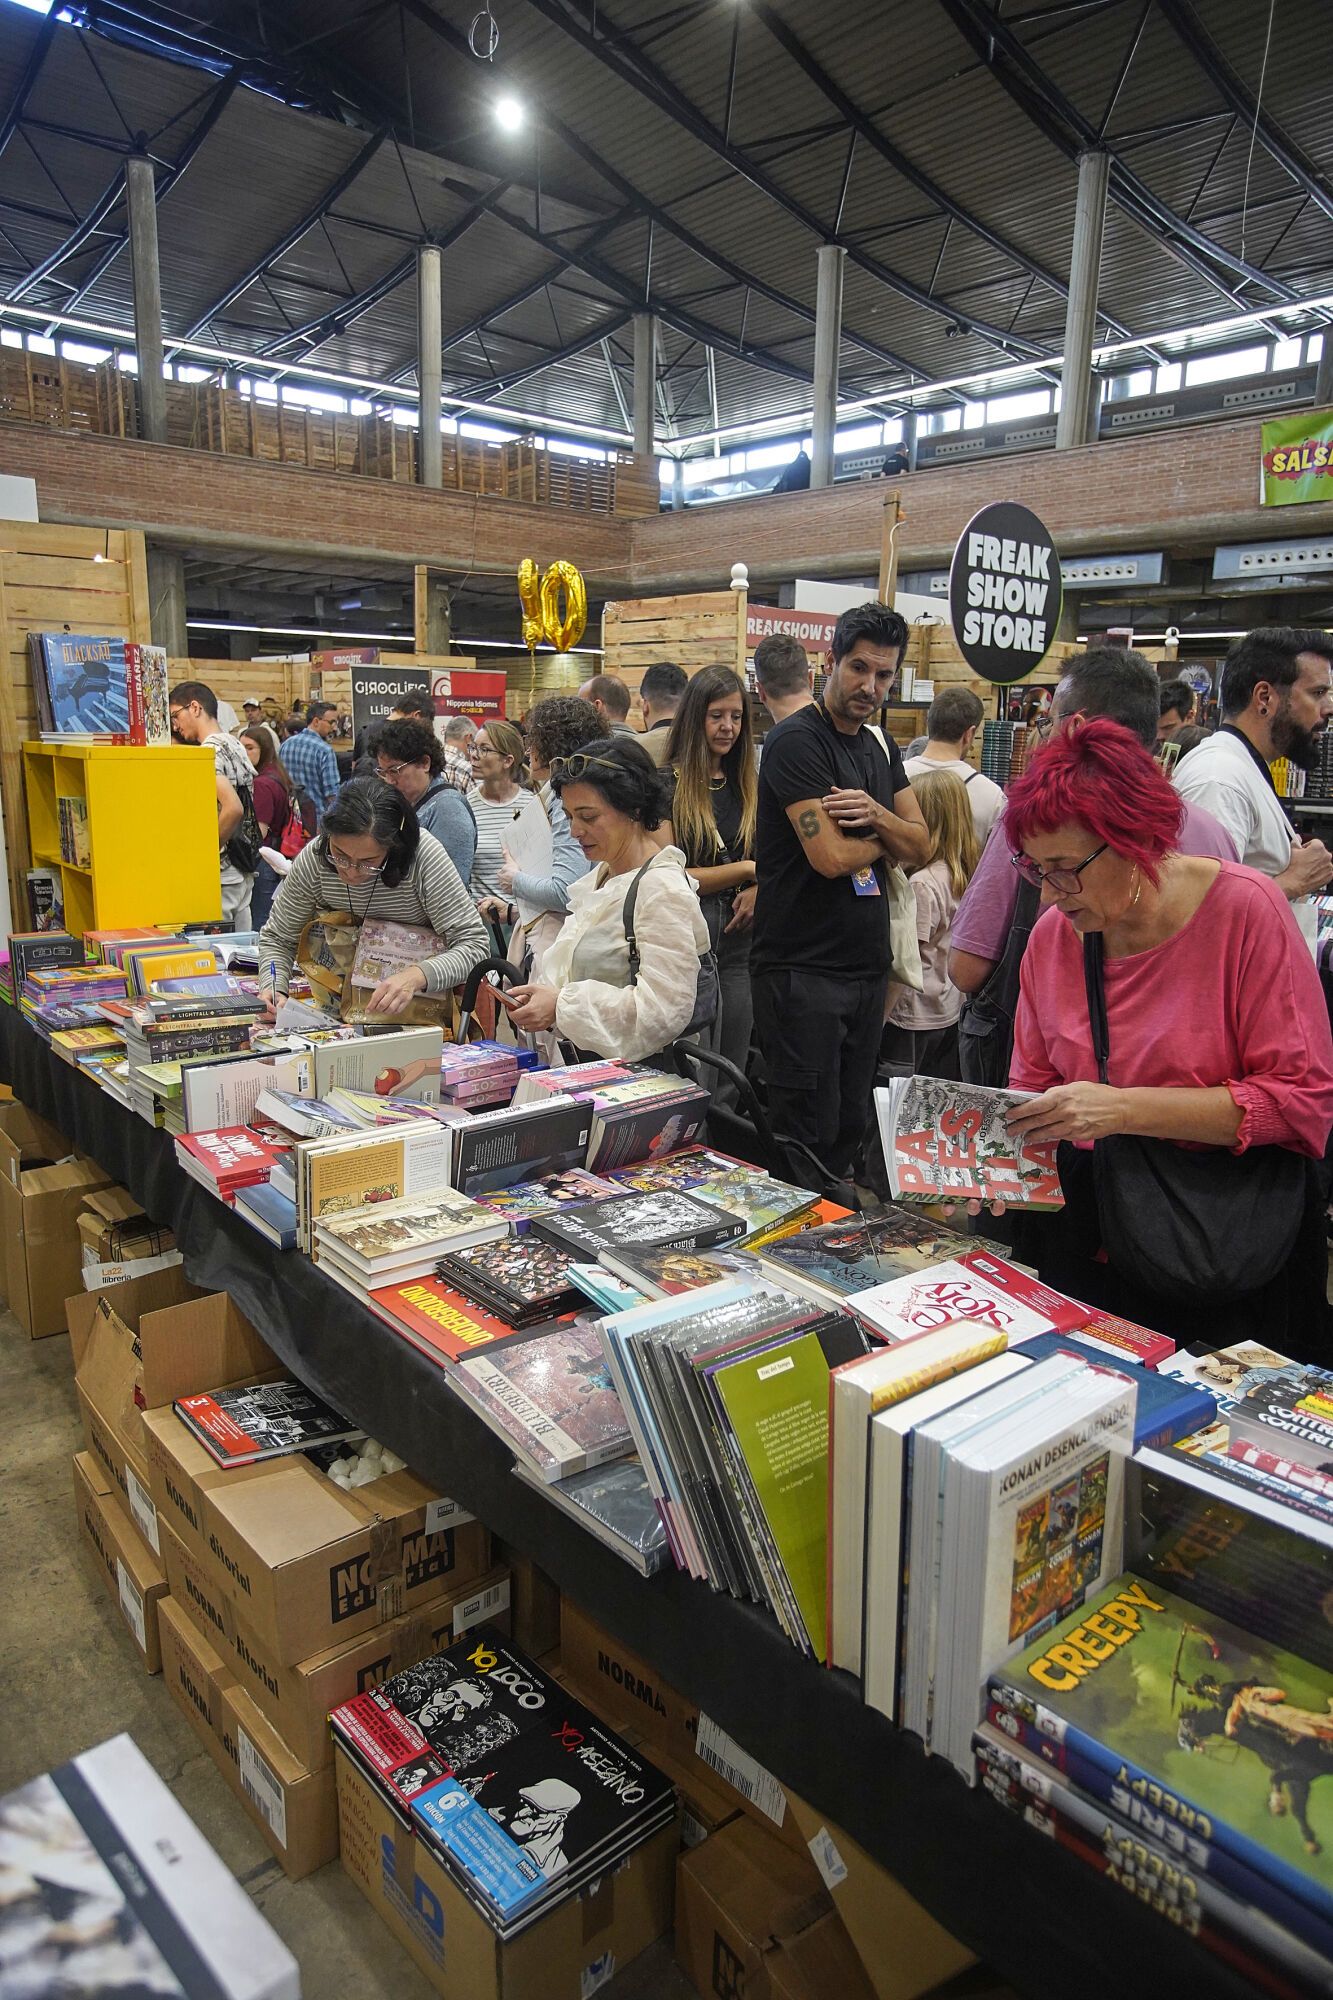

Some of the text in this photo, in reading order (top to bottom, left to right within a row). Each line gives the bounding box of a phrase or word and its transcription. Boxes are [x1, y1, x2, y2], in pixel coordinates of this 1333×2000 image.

[968, 532, 1051, 581] FREAK
[967, 572, 1048, 617] SHOW
[62, 642, 111, 663] BLACKSAD
[747, 617, 822, 641] REAKSHOW
[963, 610, 1046, 653] STORE
[446, 699, 474, 710] Nipponia
[178, 1010, 209, 1018] LIGHTFALL
[458, 1068, 485, 1078] HOY
[979, 1121, 992, 1144] JOE
[102, 1267, 123, 1276] La22
[398, 1285, 496, 1347] UNDERGROUND
[480, 1373, 556, 1437] BLUEBERRY
[209, 1533, 252, 1598] ditorial
[337, 1530, 448, 1599] NOMA
[339, 1552, 449, 1614] Edirial
[185, 1574, 280, 1701] NORMA ditorial
[1027, 1582, 1166, 1693] CREEPY
[488, 1666, 546, 1710] LOCO
[598, 1650, 668, 1719] NORMA
[589, 1726, 609, 1744] ANTONIO
[577, 1744, 646, 1806] ASESINO
[423, 1801, 447, 1825] EDICIÓN
[1117, 1763, 1213, 1840] CREEPY
[1110, 1784, 1212, 1870] EERIE
[519, 1859, 538, 1879] NORMA
[1102, 1823, 1198, 1900] CREEPY
